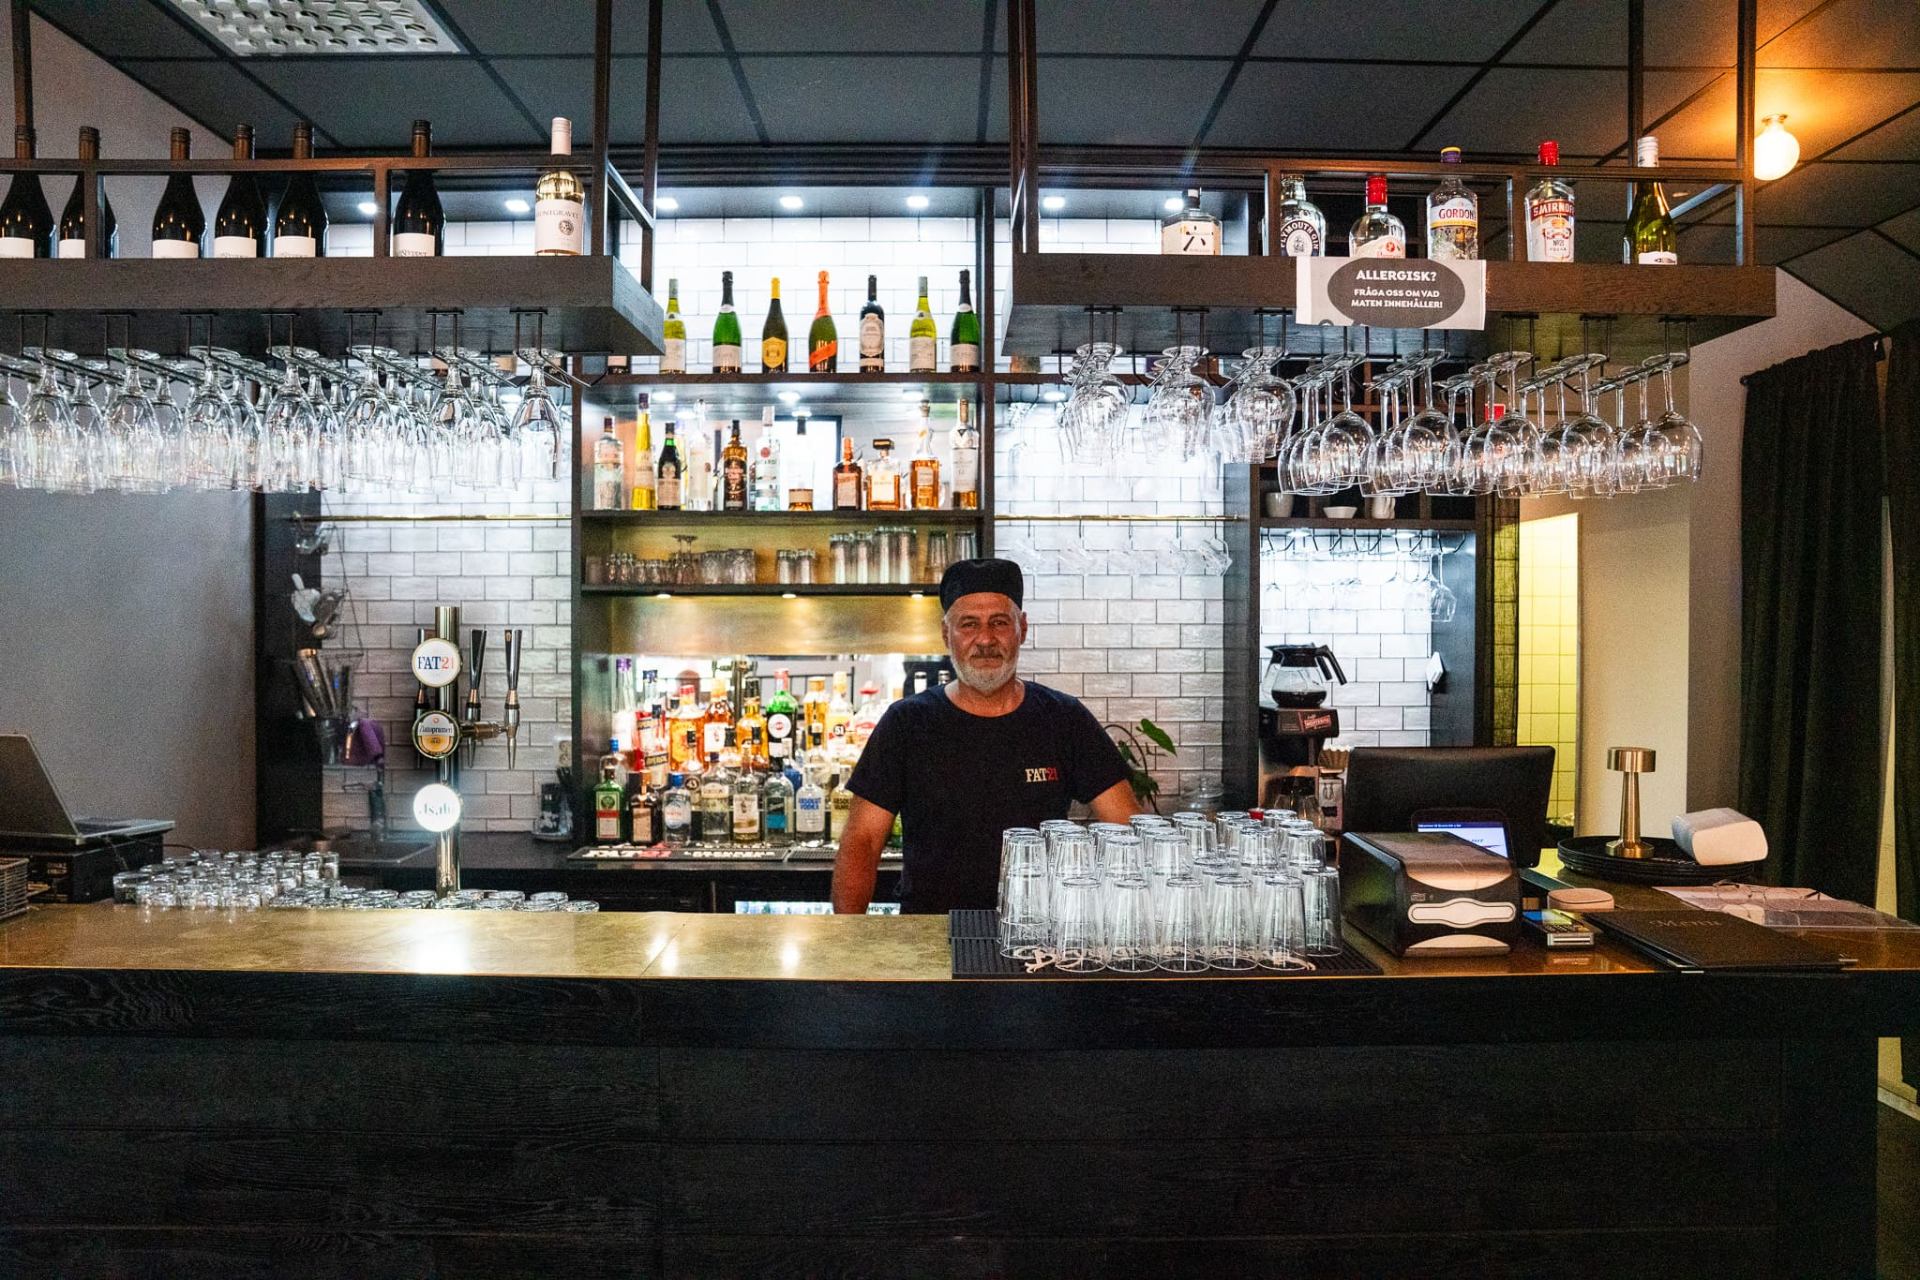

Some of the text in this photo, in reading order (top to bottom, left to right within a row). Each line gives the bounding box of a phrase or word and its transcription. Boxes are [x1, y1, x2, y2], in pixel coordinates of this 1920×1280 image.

[1438, 208, 1476, 219] GORDON
[1533, 201, 1574, 216] SMIRNOF
[1356, 269, 1437, 282] ALLERGISK?
[1354, 286, 1440, 298] FRÅGA OSS OM VAD
[1351, 298, 1443, 309] MATEN INNEHÅLLER!
[418, 656, 453, 670] FAT21
[834, 726, 845, 734] 51
[1025, 767, 1059, 783] FAT21
